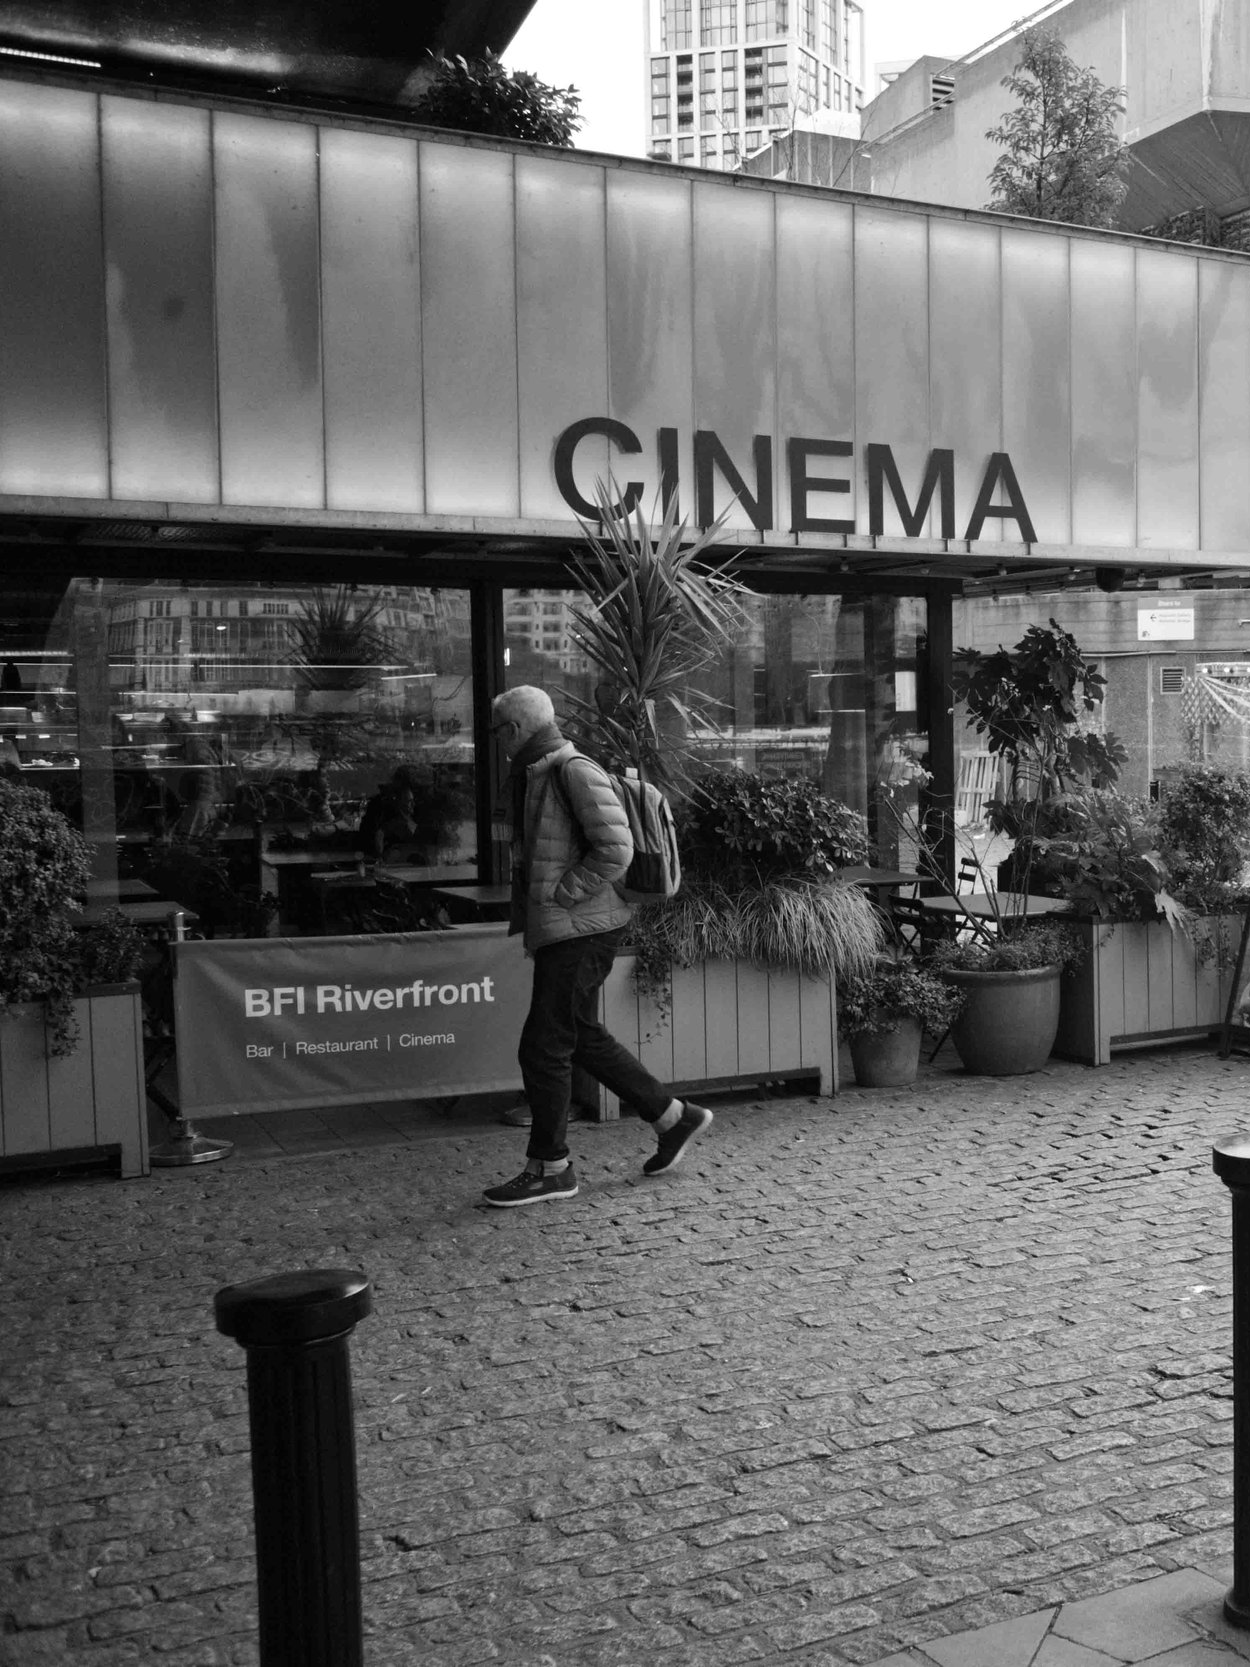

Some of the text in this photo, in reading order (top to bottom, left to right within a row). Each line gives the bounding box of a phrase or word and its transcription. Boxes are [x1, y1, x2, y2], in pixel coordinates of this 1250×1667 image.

[553, 416, 1038, 544] CINEMA
[244, 976, 495, 1018] BFI Riverfront
[246, 1031, 455, 1058] Bar Restaurant Cinema
